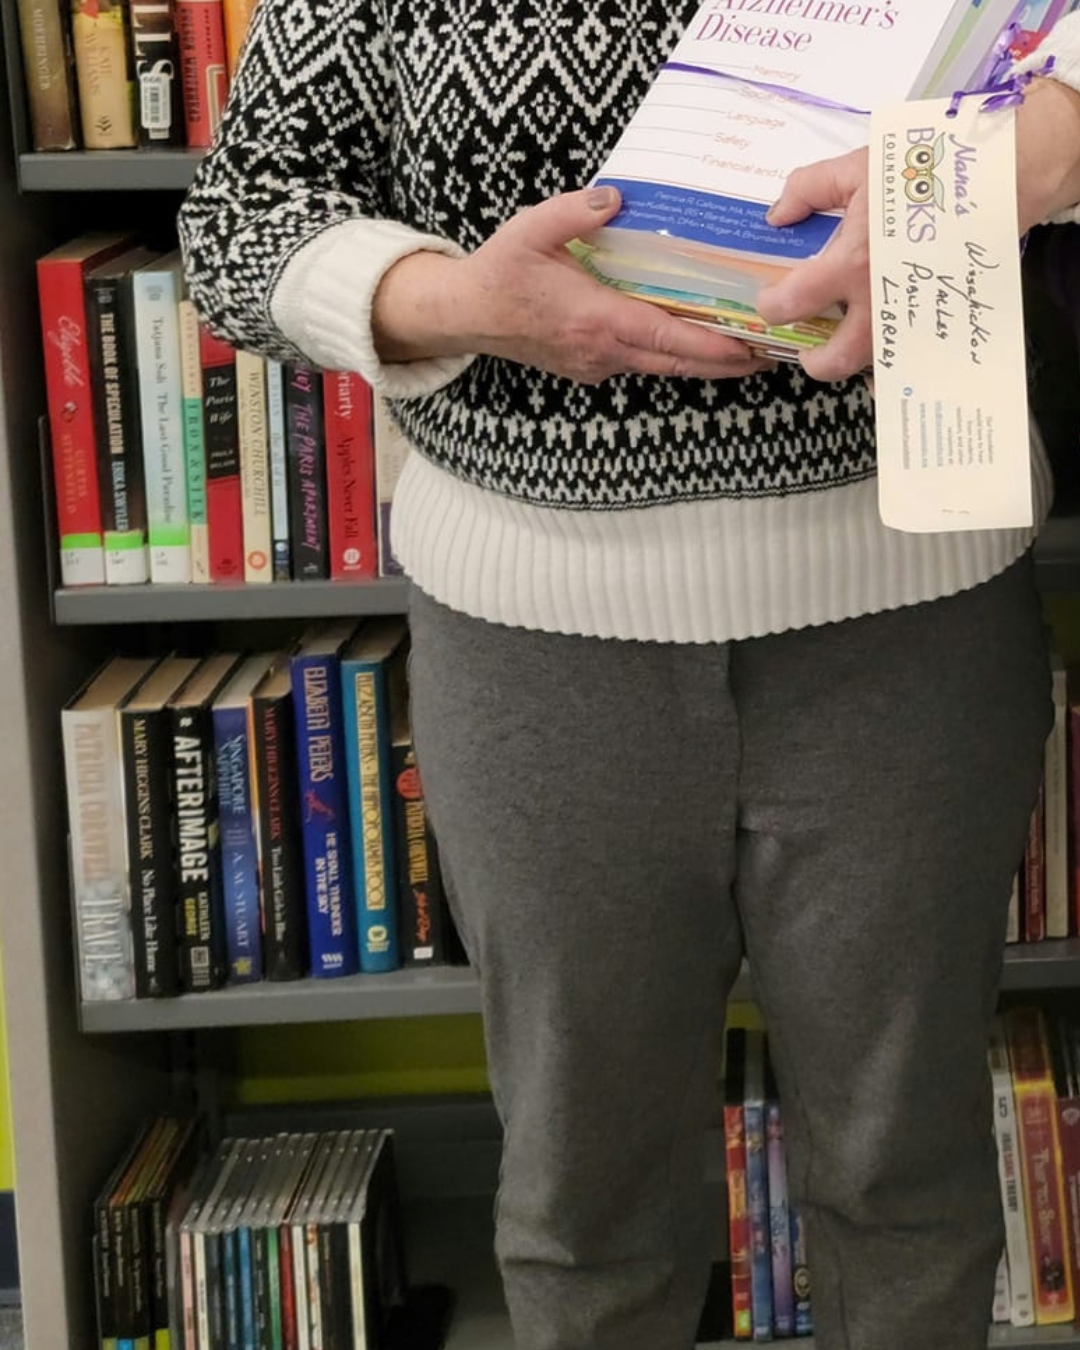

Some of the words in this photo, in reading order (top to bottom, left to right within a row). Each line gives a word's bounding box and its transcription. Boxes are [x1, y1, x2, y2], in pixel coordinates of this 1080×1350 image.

[694, 13, 813, 53] Disease
[753, 64, 800, 83] Memory
[713, 131, 751, 148] Safety
[726, 110, 786, 130] Language
[701, 154, 752, 175] Financial
[754, 163, 779, 178] and
[885, 133, 897, 238] FOUNDATION
[906, 127, 937, 244] BOOKS
[948, 133, 979, 218] Nana's
[101, 313, 115, 333] THE
[102, 335, 118, 364] BOOK
[104, 366, 119, 381] OF
[209, 375, 232, 388] The
[106, 383, 124, 454] SPECULATION
[251, 371, 265, 440] WINSTON
[292, 402, 314, 432] THE
[292, 432, 317, 477] PARIS
[253, 442, 267, 517] CHURCHILL
[340, 480, 357, 513] Never
[300, 479, 321, 552] APARTMENT
[344, 515, 359, 539] Fall
[134, 720, 148, 756] MARY
[308, 735, 334, 783] PETERS
[135, 757, 151, 813] HIGGINS
[174, 735, 208, 883] AFTERIMAGE
[139, 815, 154, 861] CLARK
[328, 884, 343, 937] THUNDER
